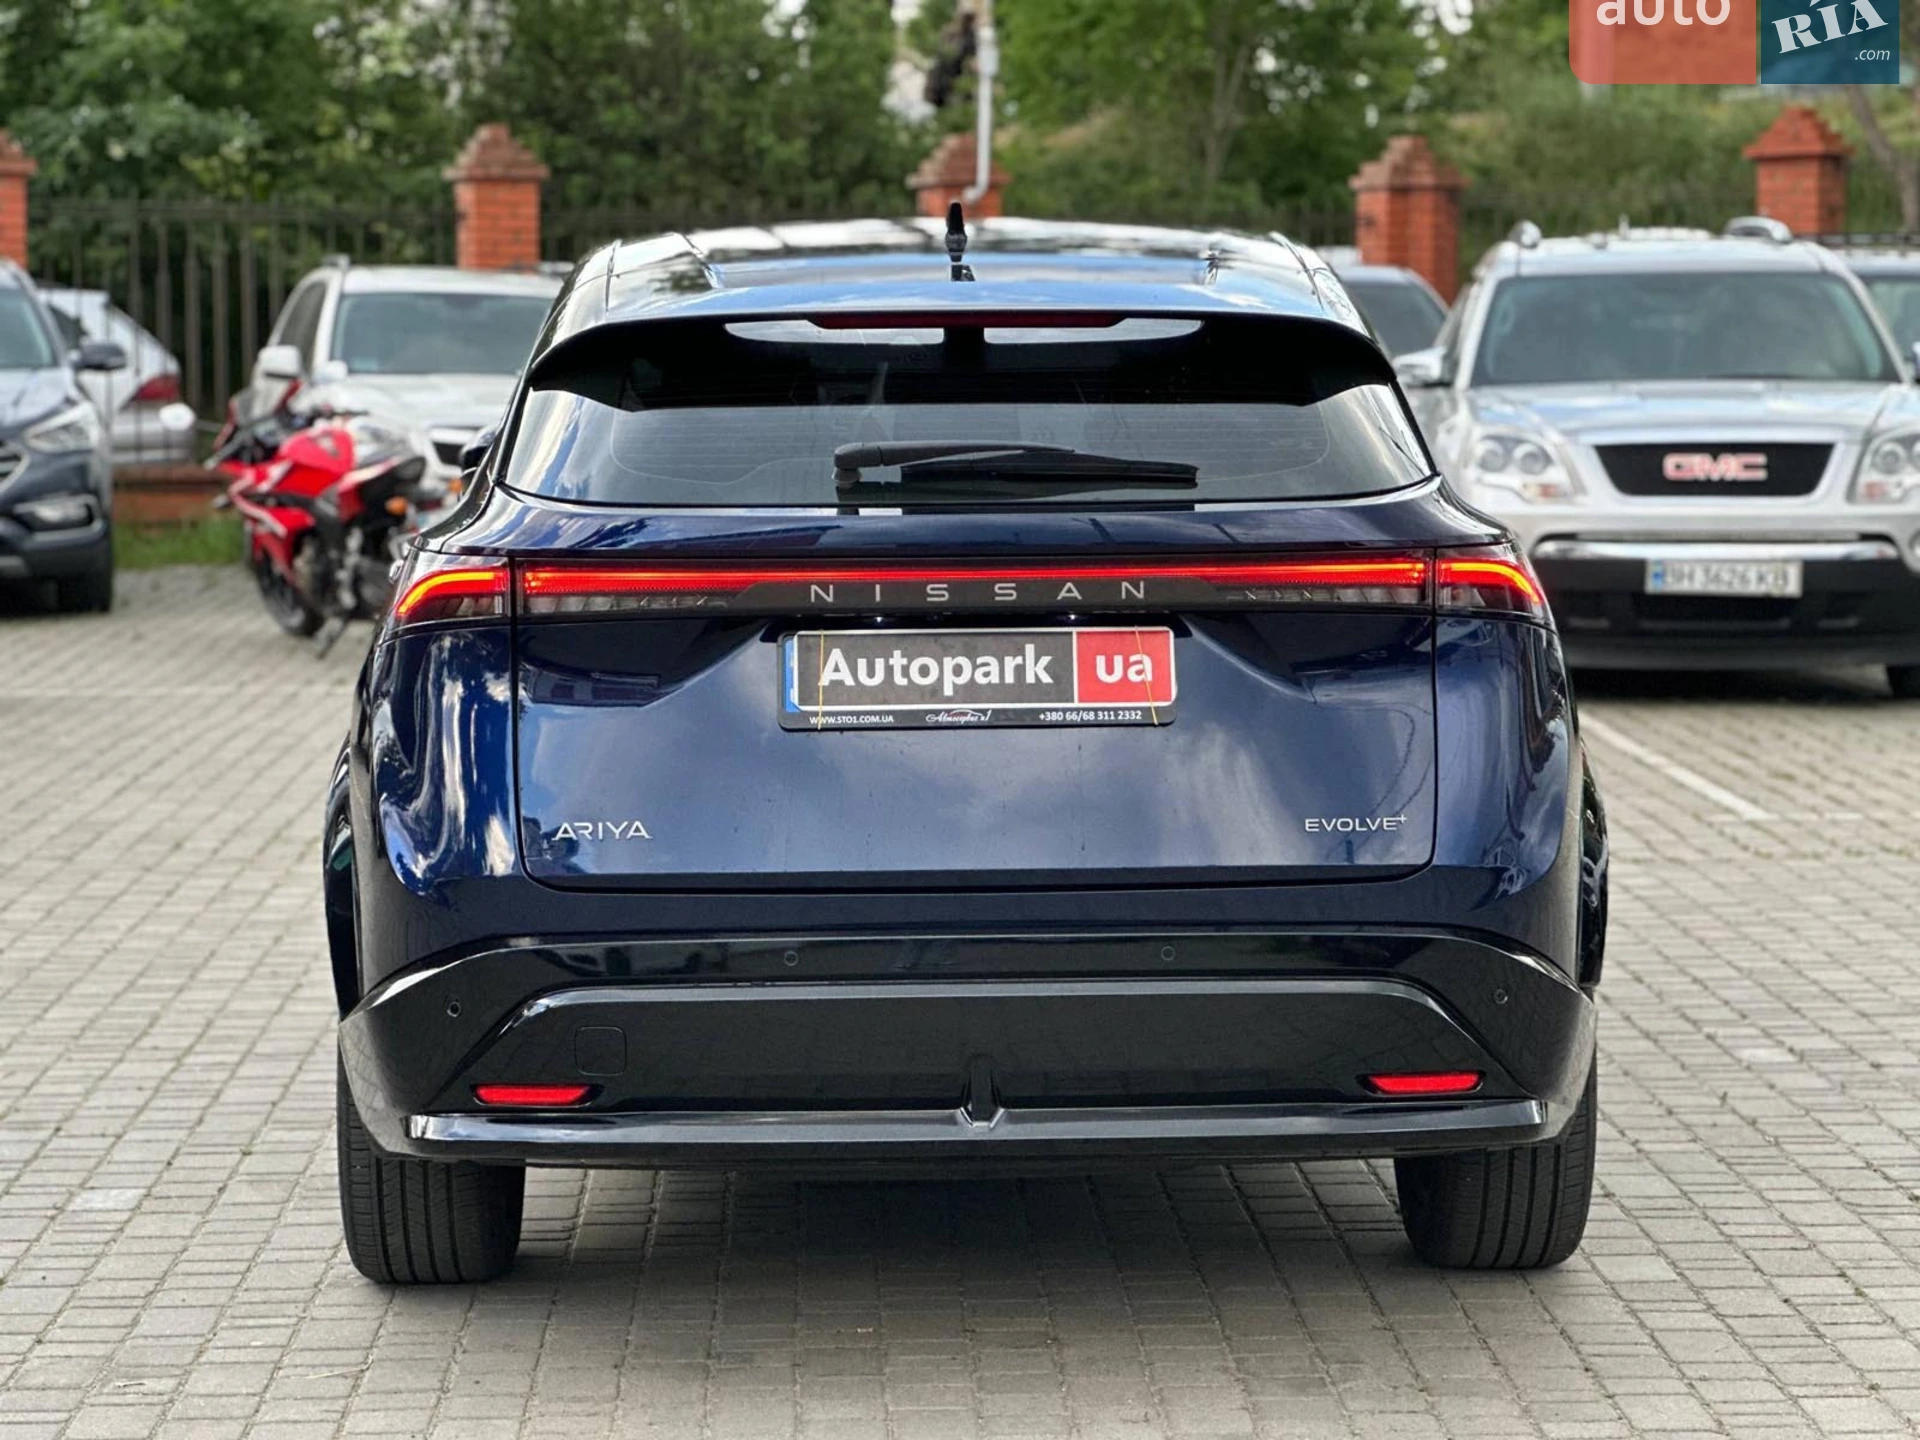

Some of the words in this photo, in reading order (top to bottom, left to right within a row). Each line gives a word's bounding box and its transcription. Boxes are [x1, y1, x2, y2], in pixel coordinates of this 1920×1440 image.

[1663, 453, 1767, 481] GMC
[810, 581, 1145, 603] NISSAN
[818, 643, 1053, 697] Autopark
[1095, 653, 1153, 684] ua
[1039, 712, 1063, 721] +380
[1065, 711, 1094, 722] 66/68
[1097, 710, 1115, 720] 311
[1117, 709, 1142, 720] 2332
[551, 820, 653, 841] ARIYA
